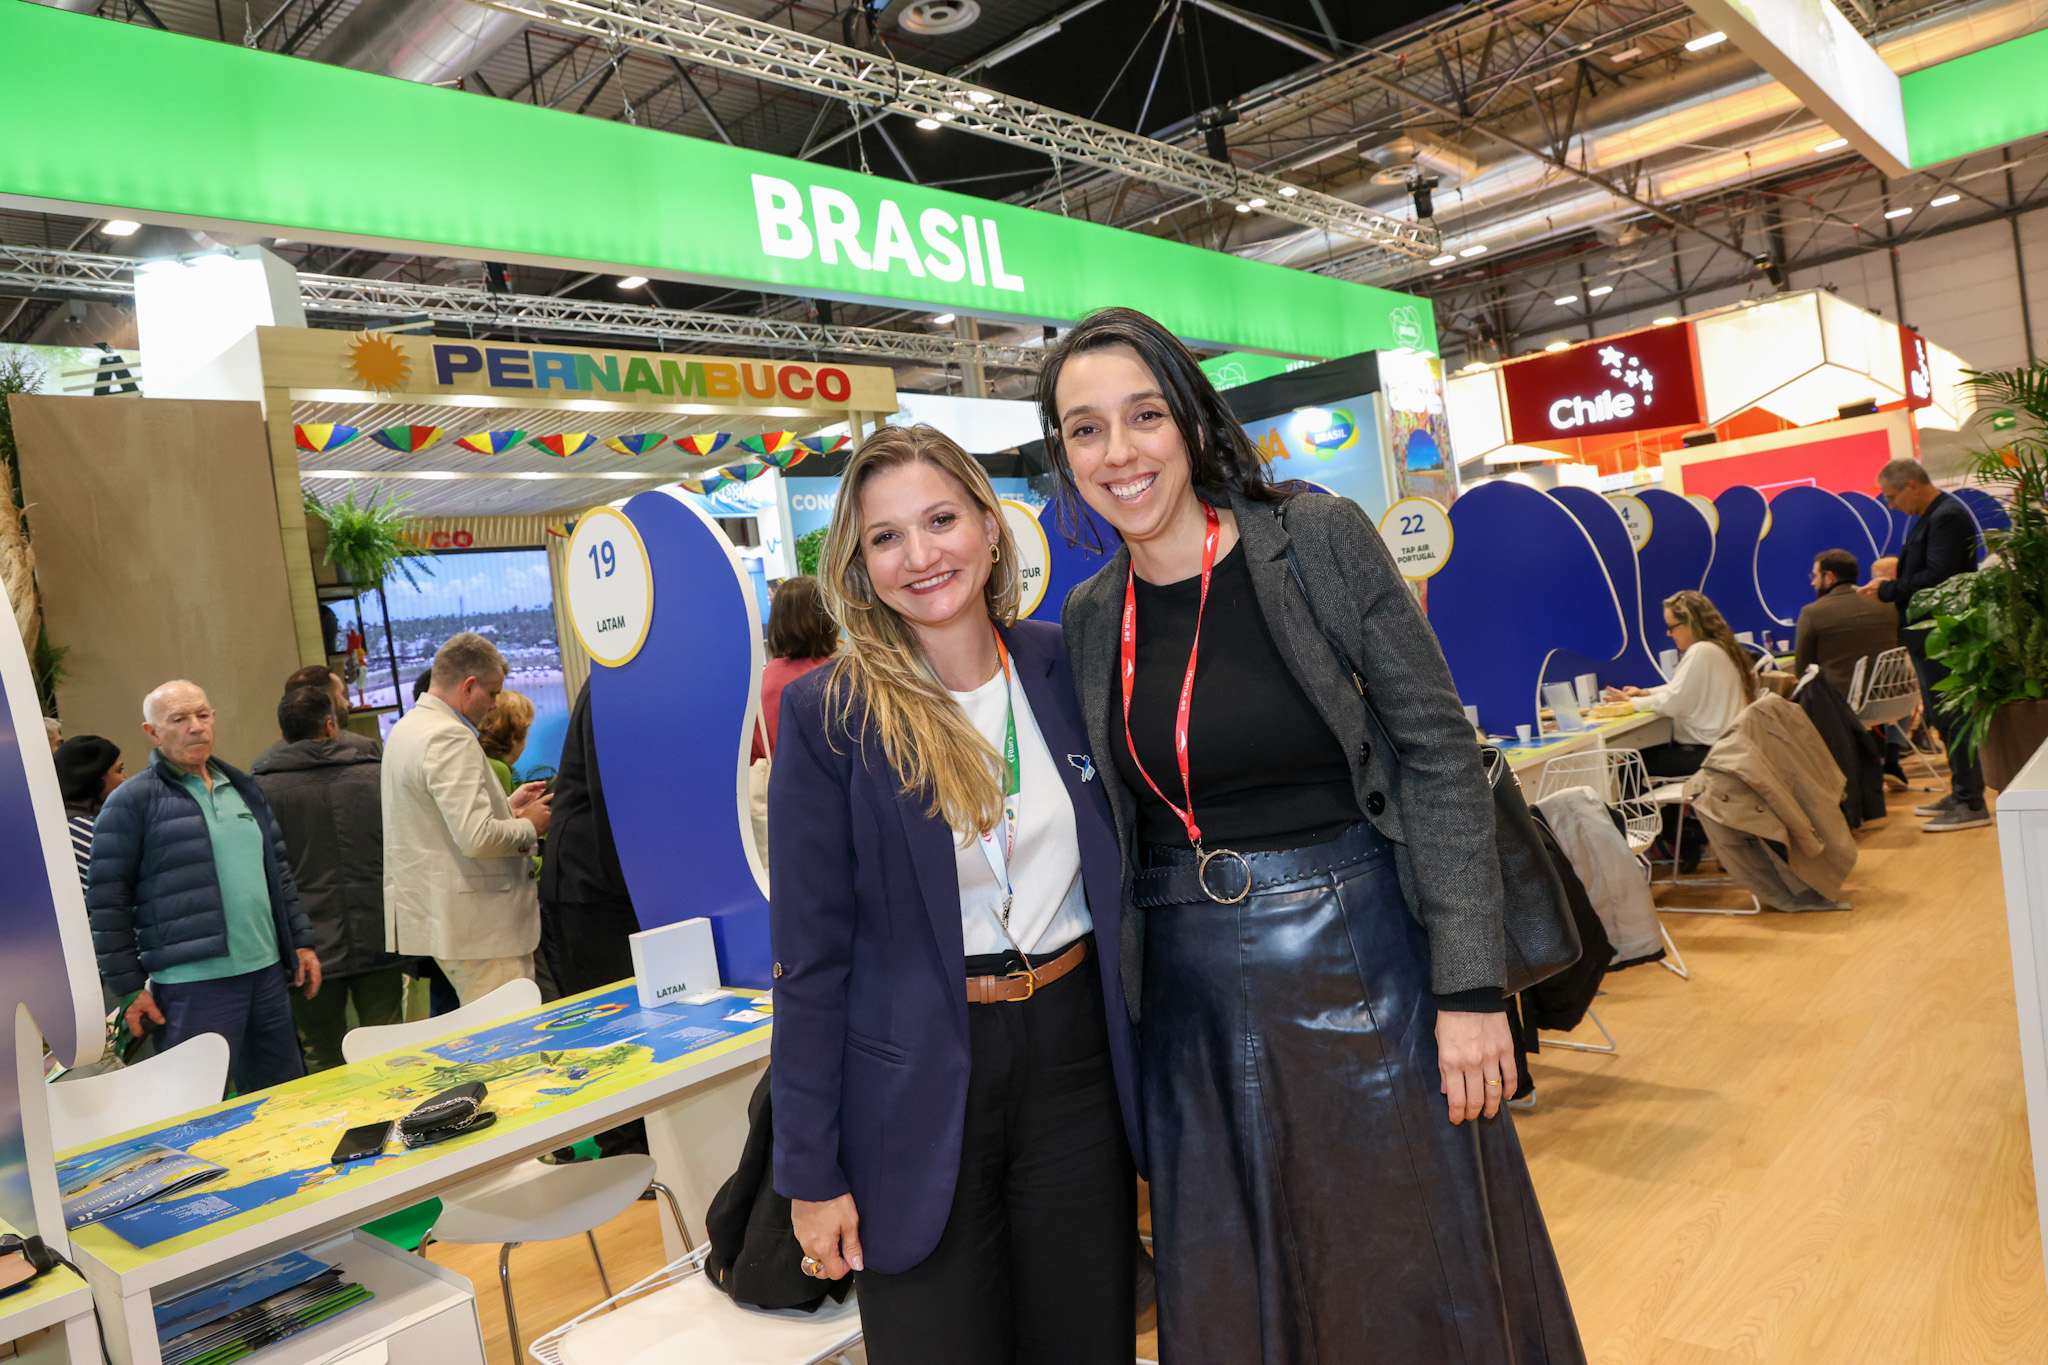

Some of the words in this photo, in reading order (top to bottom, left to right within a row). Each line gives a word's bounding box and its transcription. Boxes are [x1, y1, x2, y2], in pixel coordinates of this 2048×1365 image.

[750, 173, 1025, 292] BRASIL
[432, 344, 852, 402] PERNAMBUCO
[1549, 389, 1635, 430] Chile
[1314, 428, 1348, 444] BRASIL
[1621, 507, 1630, 521] 4
[1400, 514, 1425, 535] 22
[1397, 552, 1436, 564] PORTUGAL
[1401, 546, 1416, 555] TAP
[1417, 544, 1430, 552] AIR
[588, 540, 616, 580] 19
[596, 615, 626, 633] LATAM
[1123, 603, 1134, 642] ifema.es
[1180, 669, 1194, 711] ifema.es
[1007, 739, 1015, 759] Fitur
[656, 983, 687, 999] LATAM
[553, 1009, 602, 1026] BRASIL
[77, 1182, 156, 1222] Brasil
[87, 1185, 126, 1205] MUNDO
